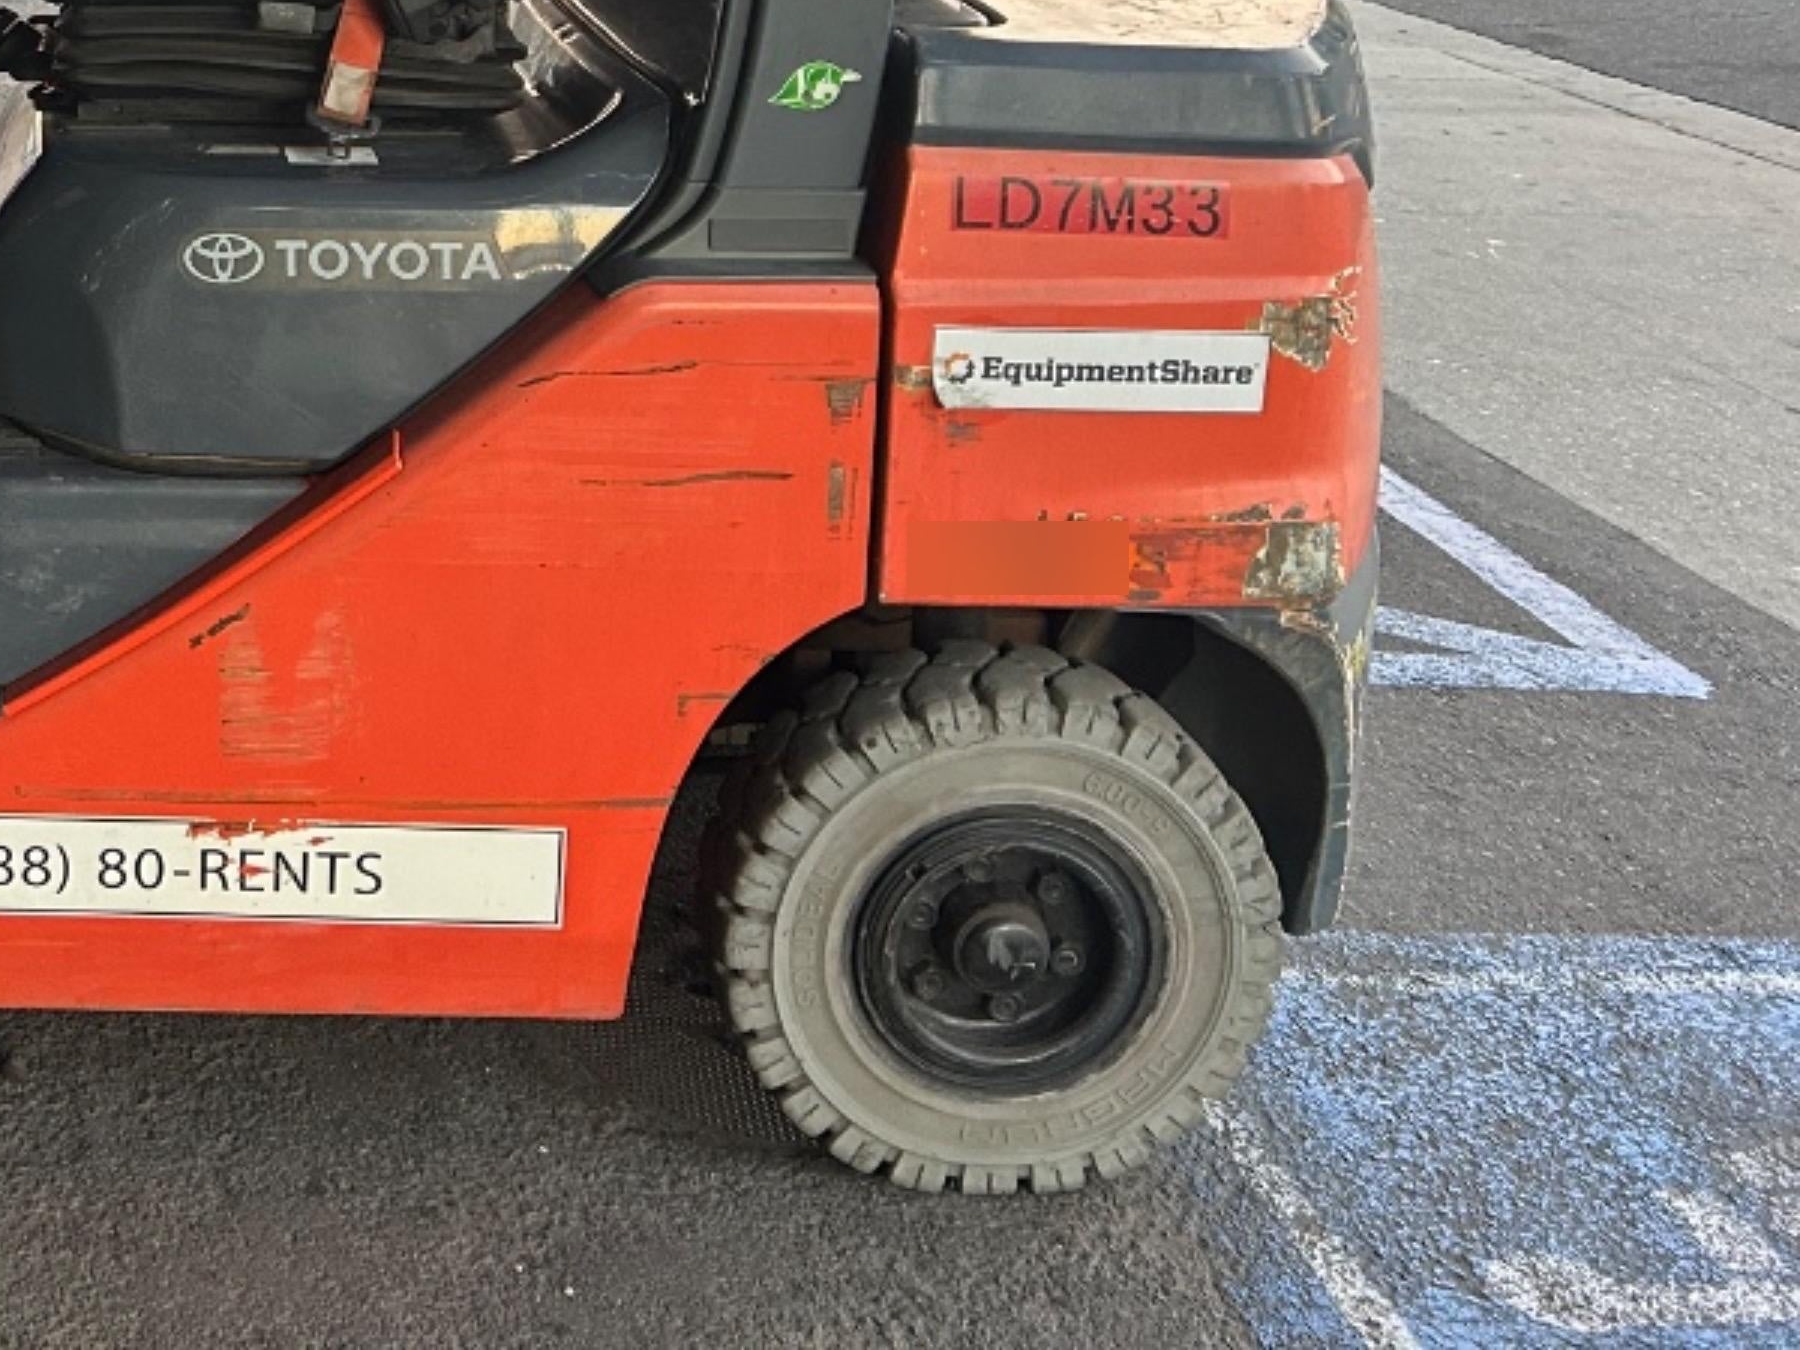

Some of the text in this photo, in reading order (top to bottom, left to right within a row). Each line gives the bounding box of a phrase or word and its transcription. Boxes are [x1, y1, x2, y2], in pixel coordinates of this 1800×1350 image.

[955, 176, 1220, 237] LD7M33
[275, 238, 502, 281] TOYOTA
[980, 356, 1255, 388] EquipmentShare
[97, 846, 384, 896] 80-RENTS
